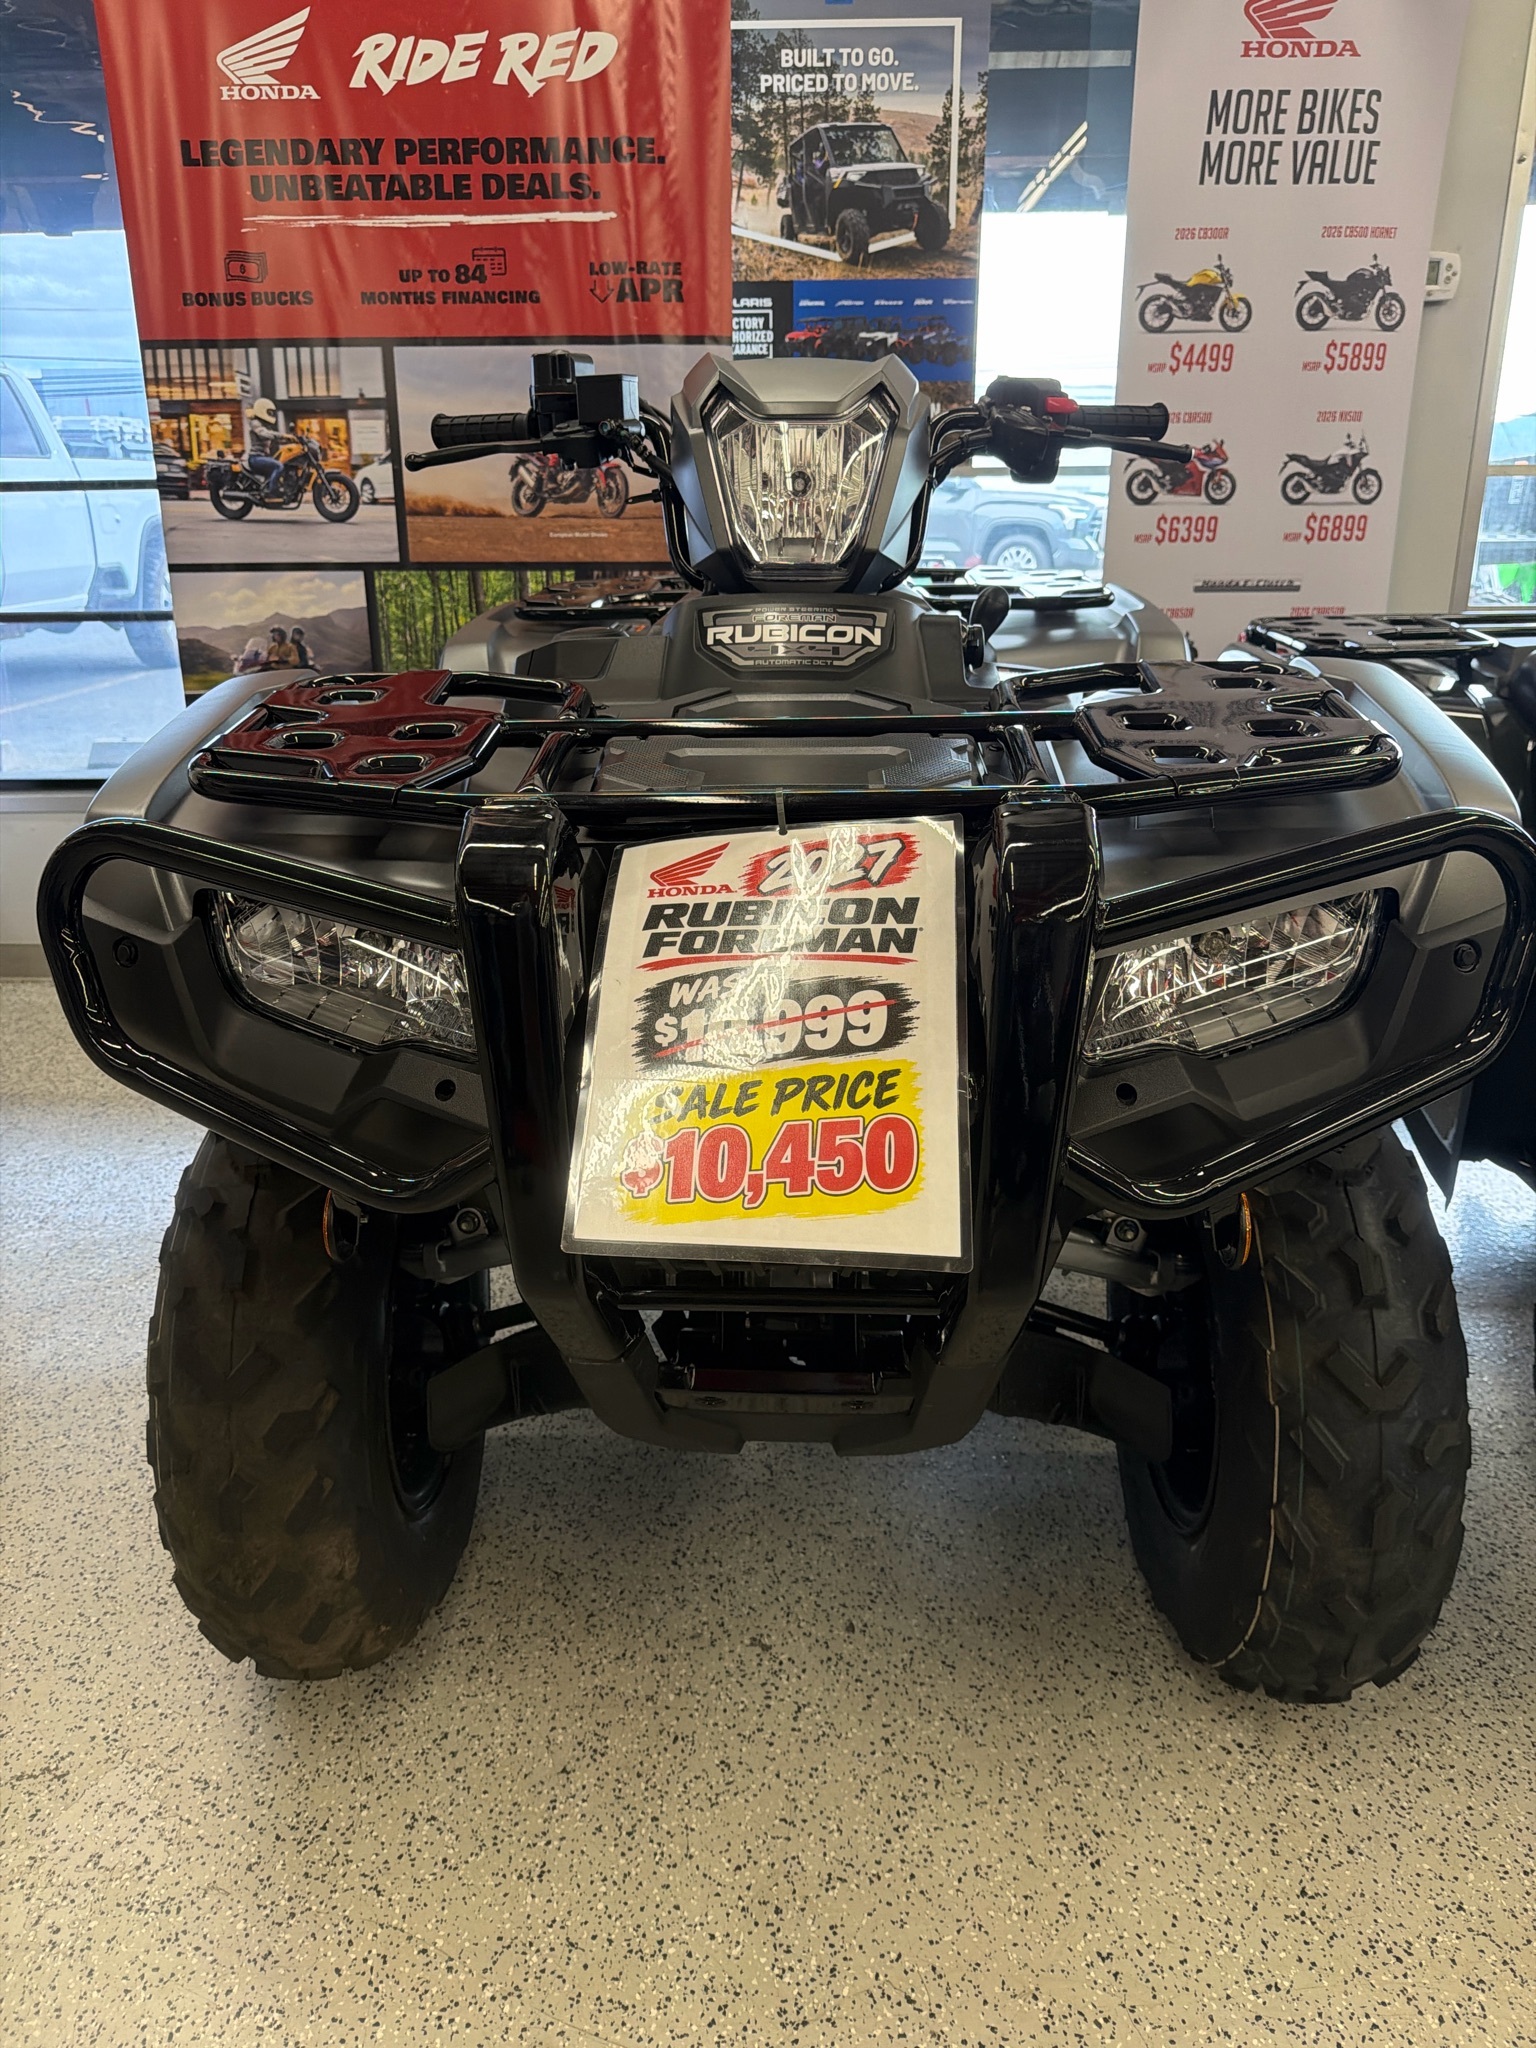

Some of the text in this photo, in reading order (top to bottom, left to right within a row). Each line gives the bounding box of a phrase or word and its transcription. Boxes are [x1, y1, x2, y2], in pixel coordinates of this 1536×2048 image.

[780, 47, 899, 68] BUILT TO GO.
[1240, 40, 1361, 58] HONDA
[349, 27, 619, 97] RIDE RED
[220, 85, 321, 100] HONDA
[760, 72, 920, 94] PRICED TO MOVE.
[1206, 88, 1382, 135] MORE BIKES
[180, 136, 667, 167] LEGENDARY PERFORMANCE.
[1199, 140, 1381, 186] MORE VALUE
[249, 171, 601, 202] UNBEATABLE DEALS.
[1175, 227, 1196, 240] 2026
[1321, 226, 1398, 239] 2026 CB500 HORNET
[399, 263, 488, 285] UP TO 84
[589, 261, 683, 277] LOW-RATE
[182, 290, 314, 307] BONUS BUCKS
[361, 290, 541, 306] MONTHS FINANCING
[616, 279, 685, 303] APR
[732, 297, 773, 307] LARIS
[732, 316, 765, 330] CTORY
[732, 330, 774, 343] HORIZED
[732, 343, 769, 356] ARANCE
[1148, 341, 1234, 375] MSRP $4499
[1302, 339, 1387, 374] MSRP $5899
[1169, 412, 1181, 424] 26
[1155, 514, 1219, 546] $6399
[1304, 512, 1368, 544] $6899
[752, 613, 838, 623] FOREMAN
[706, 624, 882, 646] RUBICON
[647, 838, 906, 899] HONDA 2027
[770, 1069, 902, 1117] PRICE
[620, 1113, 919, 1209] $10,450
